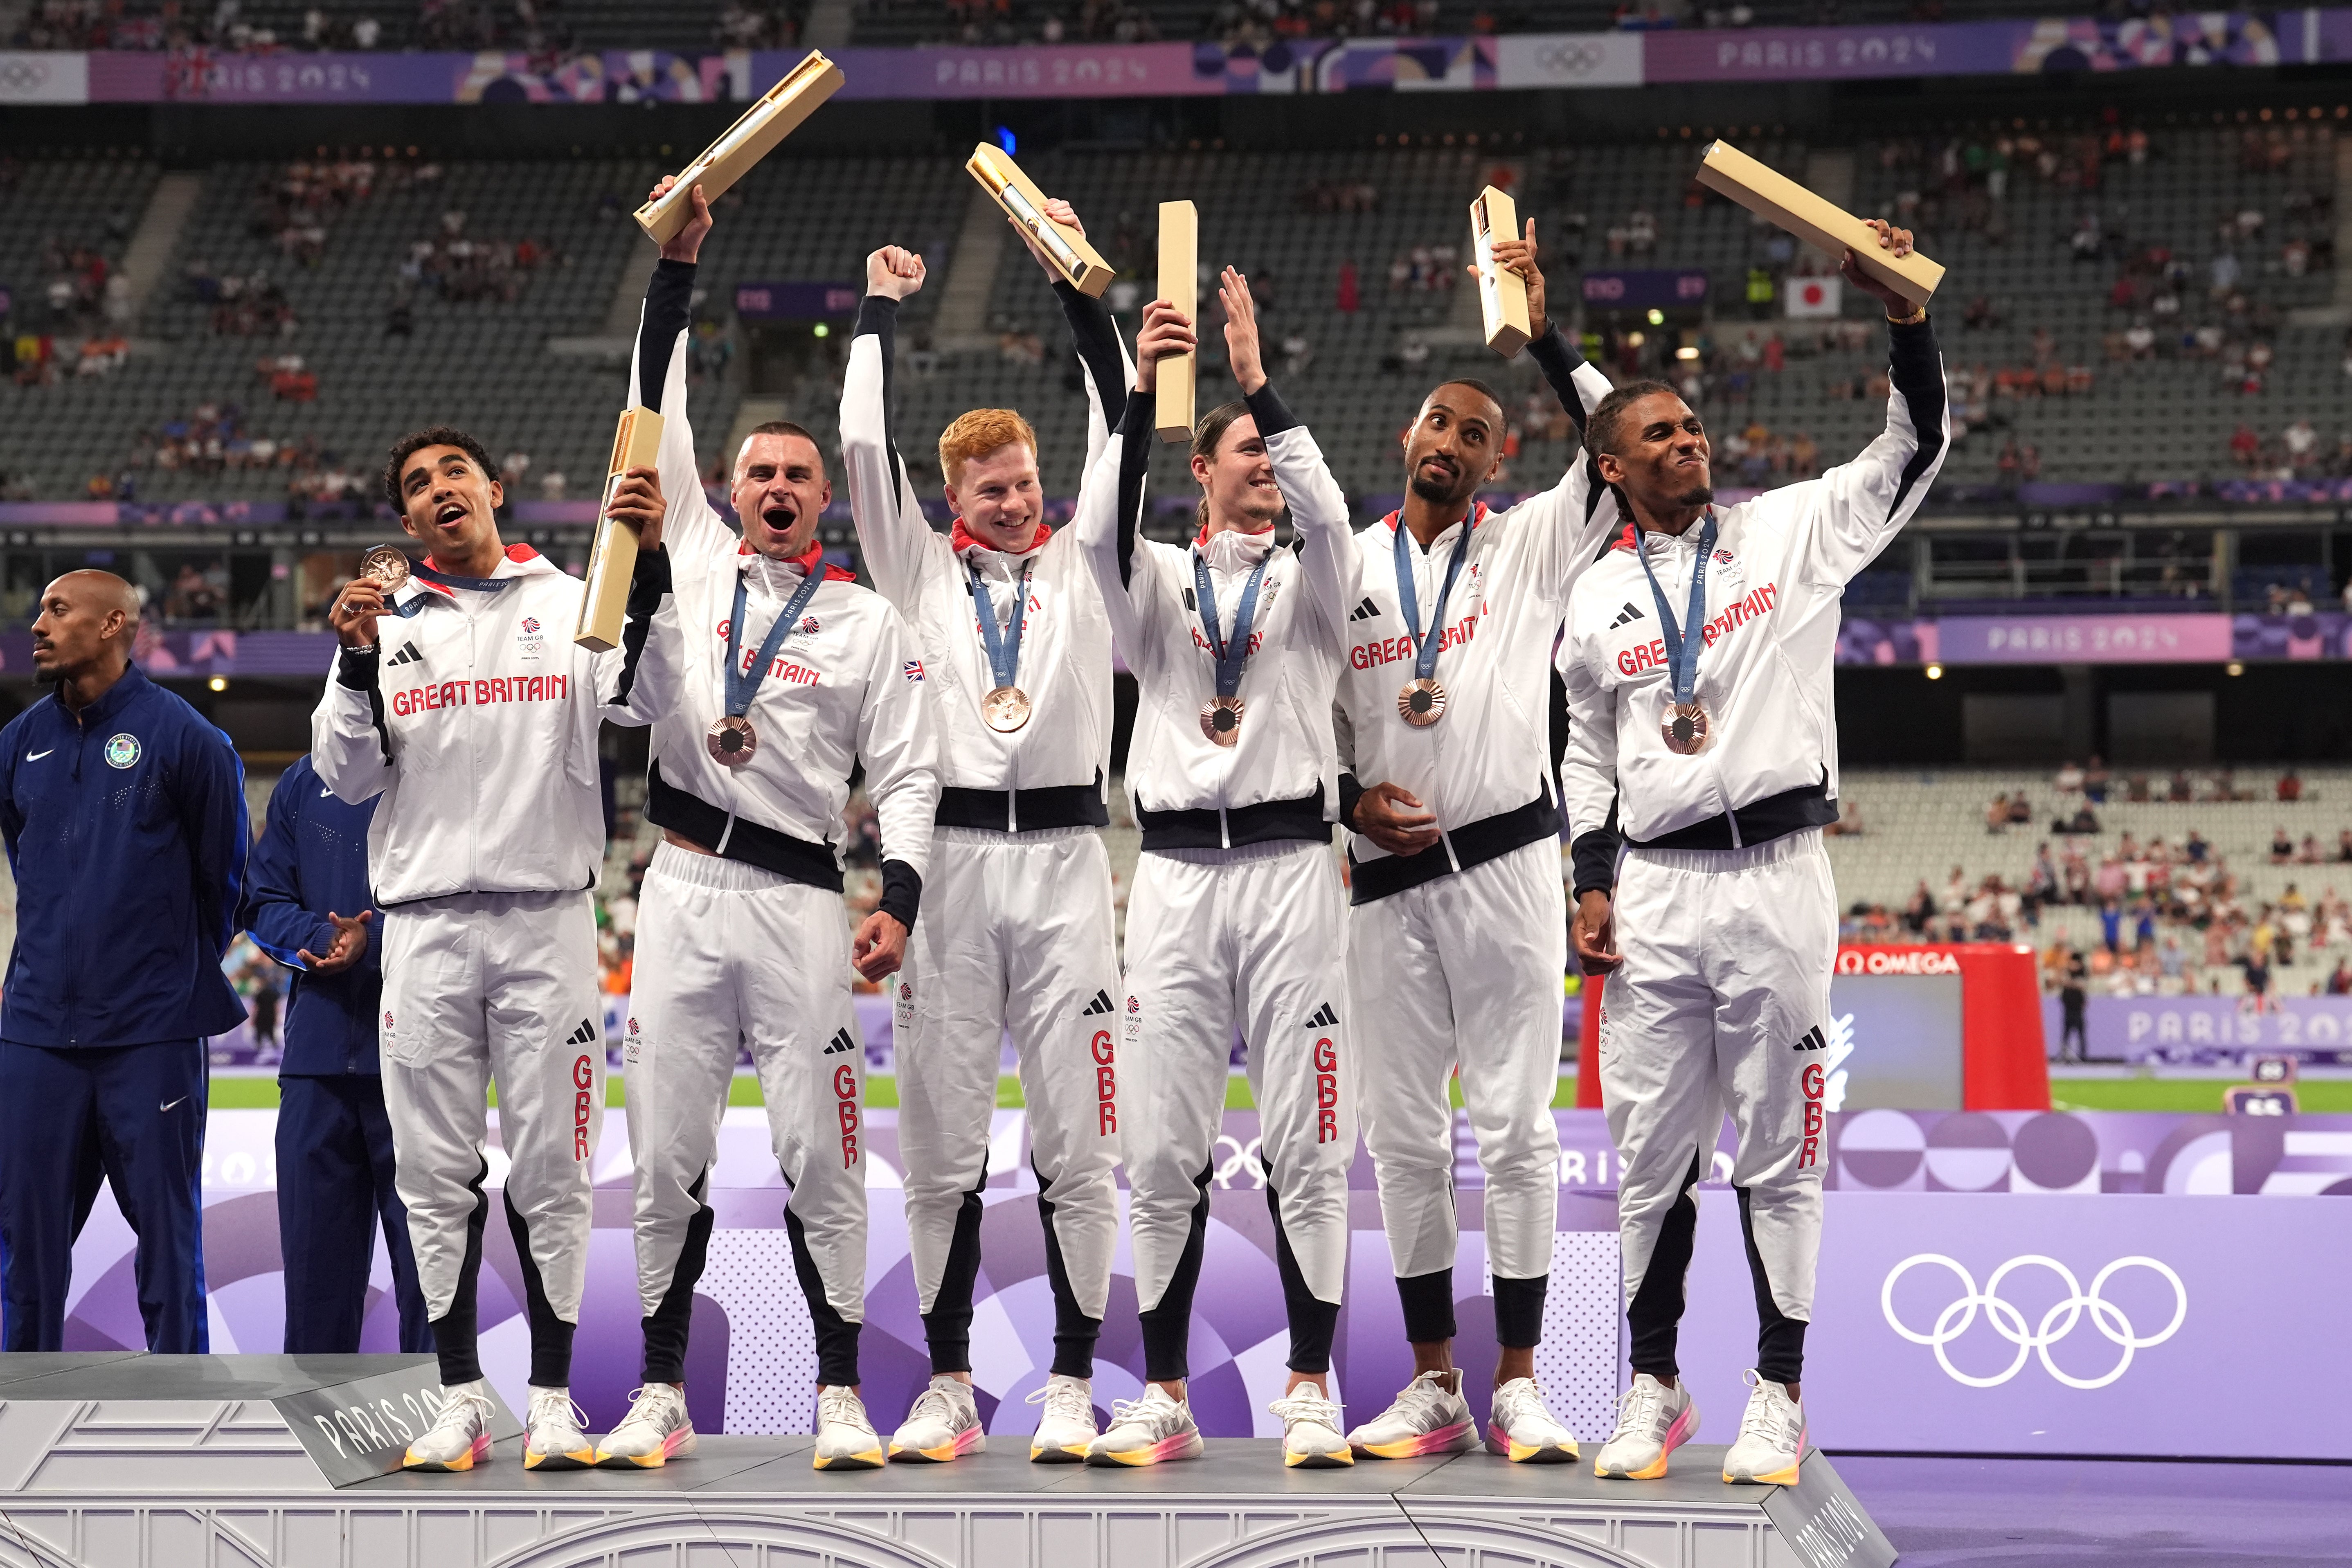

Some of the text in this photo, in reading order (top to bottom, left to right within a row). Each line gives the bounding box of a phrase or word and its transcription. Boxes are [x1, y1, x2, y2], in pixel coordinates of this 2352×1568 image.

[1718, 35, 1936, 67] PARIS 2024
[213, 63, 371, 92] RIS 2024
[936, 58, 1146, 86] PARIS 2024
[1701, 538, 1711, 559] 2024
[1717, 566, 1733, 576] TEAM
[798, 581, 813, 599] 2024
[1702, 583, 1776, 649] BRITAIN
[1987, 625, 2178, 652] PARIS 2024
[742, 649, 820, 687] BITAIN
[1618, 639, 1668, 676] GRE
[393, 675, 566, 716] GREAT BRITAIN
[1866, 951, 1961, 975] OMEGA
[2128, 1010, 2352, 1045] PARIS 20
[1092, 1030, 1116, 1136] GBR
[1314, 1037, 1338, 1144] GBR
[573, 1055, 592, 1161] GBR
[833, 1064, 858, 1169] GBR
[1798, 1063, 1824, 1169] GBR
[402, 1384, 445, 1432] 20
